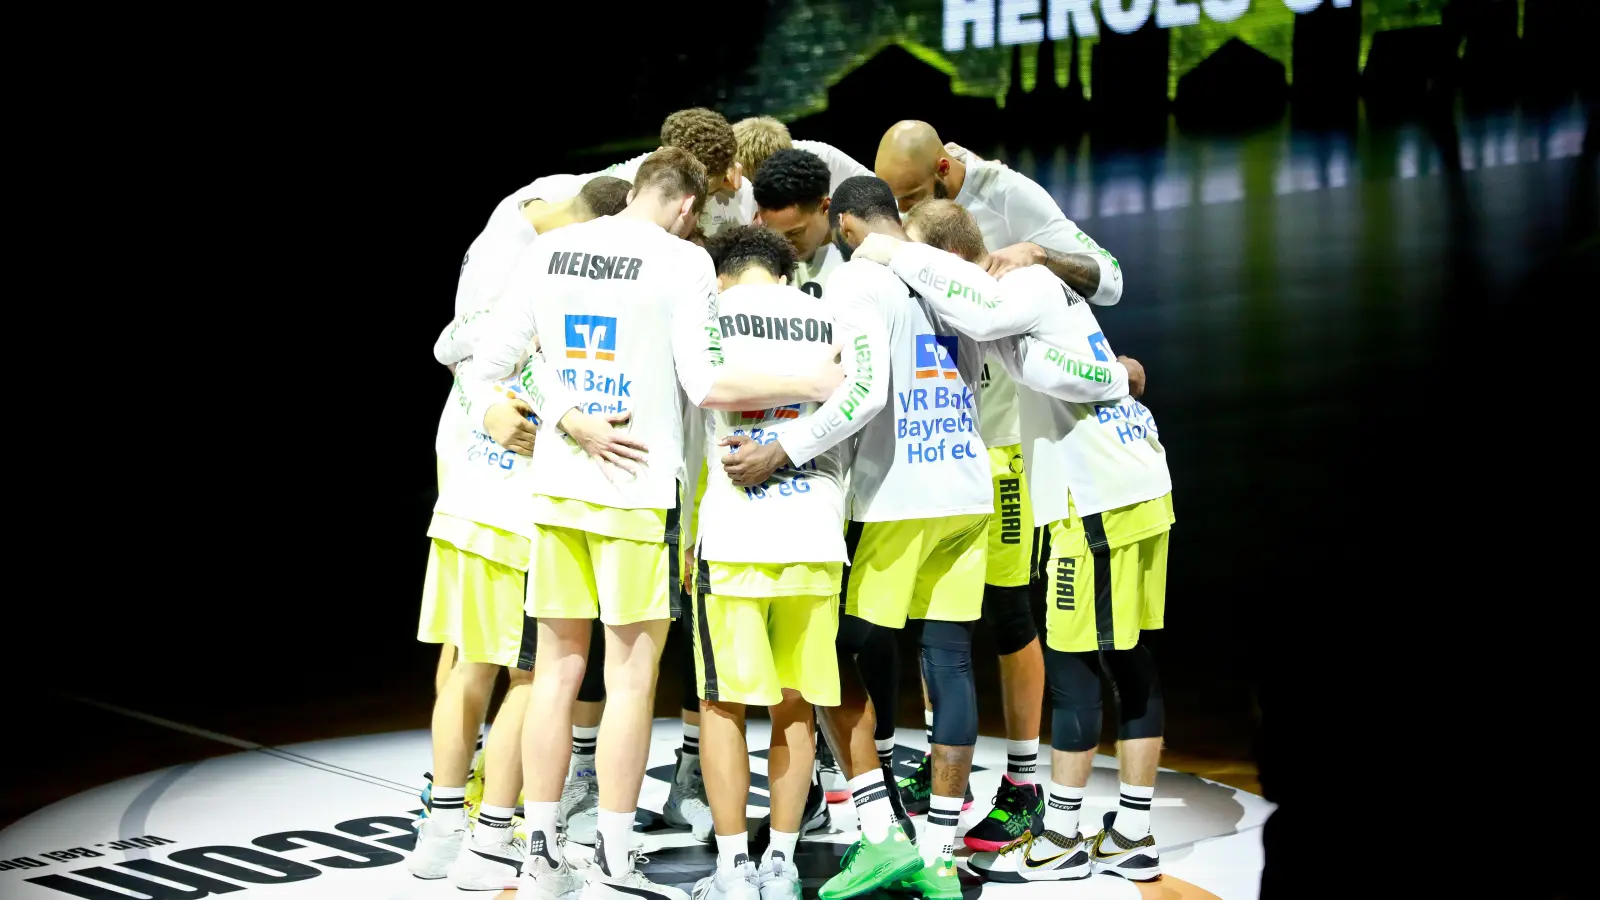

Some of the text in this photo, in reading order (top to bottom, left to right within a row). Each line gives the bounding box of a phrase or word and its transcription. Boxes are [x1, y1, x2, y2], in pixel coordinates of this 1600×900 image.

[547, 251, 643, 281] MEISNER
[718, 313, 833, 345] ROBINSON
[1044, 347, 1112, 384] printzen
[584, 372, 632, 397] Bank
[898, 389, 929, 413] VR
[488, 450, 516, 470] eG
[908, 438, 946, 464] Hof
[778, 474, 811, 497] eG
[999, 477, 1021, 545] REHAU
[1056, 557, 1076, 611] EHAU
[38, 846, 106, 863] Bei
